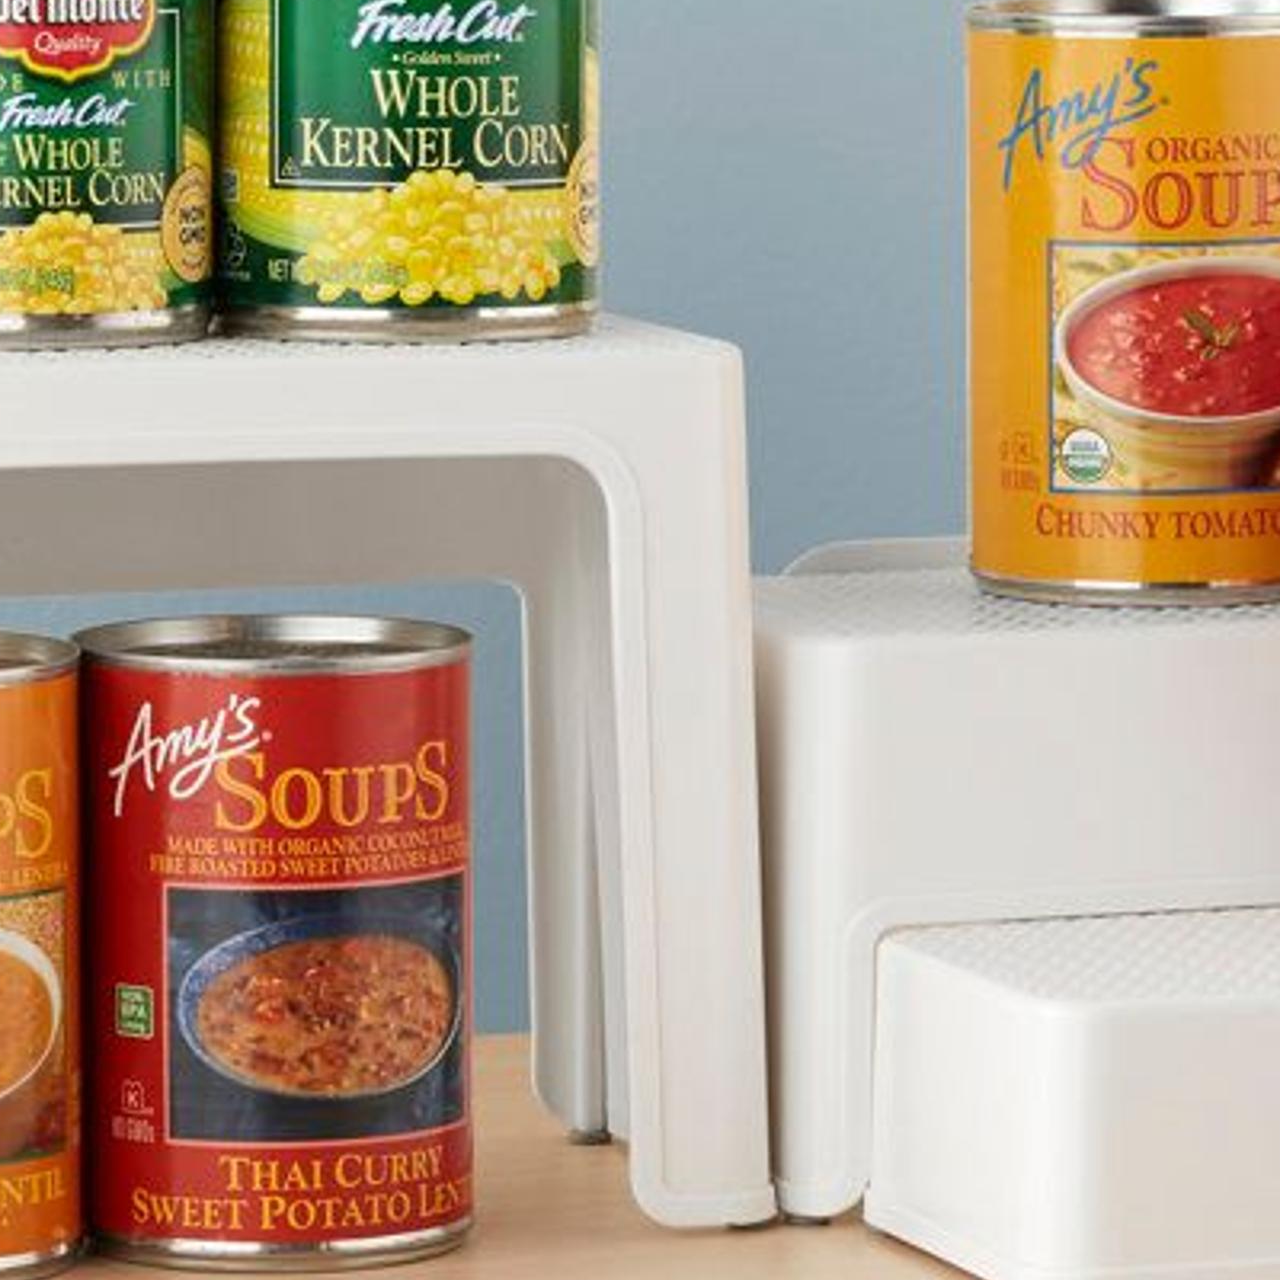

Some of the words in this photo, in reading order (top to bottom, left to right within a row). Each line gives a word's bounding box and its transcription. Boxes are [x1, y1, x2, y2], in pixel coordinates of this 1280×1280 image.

[34, 31, 102, 55] Quality
[111, 70, 172, 90] WITH
[369, 69, 520, 118] WHOLE
[300, 118, 464, 168] KERNEL
[472, 118, 572, 168] CORN
[997, 57, 1158, 193] Amy's
[11, 134, 124, 171] WHOLE
[1145, 132, 1280, 164] ORGANIC
[88, 170, 166, 206] CORN
[1036, 503, 1160, 540] CHUNKY
[109, 693, 261, 818] Amy's
[217, 740, 450, 832] SOUPS
[167, 834, 219, 856] MADE
[223, 837, 274, 856] WITH
[278, 834, 367, 857] ORGANIC
[188, 857, 276, 878] ROASTED
[280, 856, 341, 877] SWEET
[220, 1154, 321, 1191] THAI
[334, 1144, 445, 1188] CURRY
[132, 1187, 248, 1229] SWEET
[260, 1192, 411, 1230] POTATO
